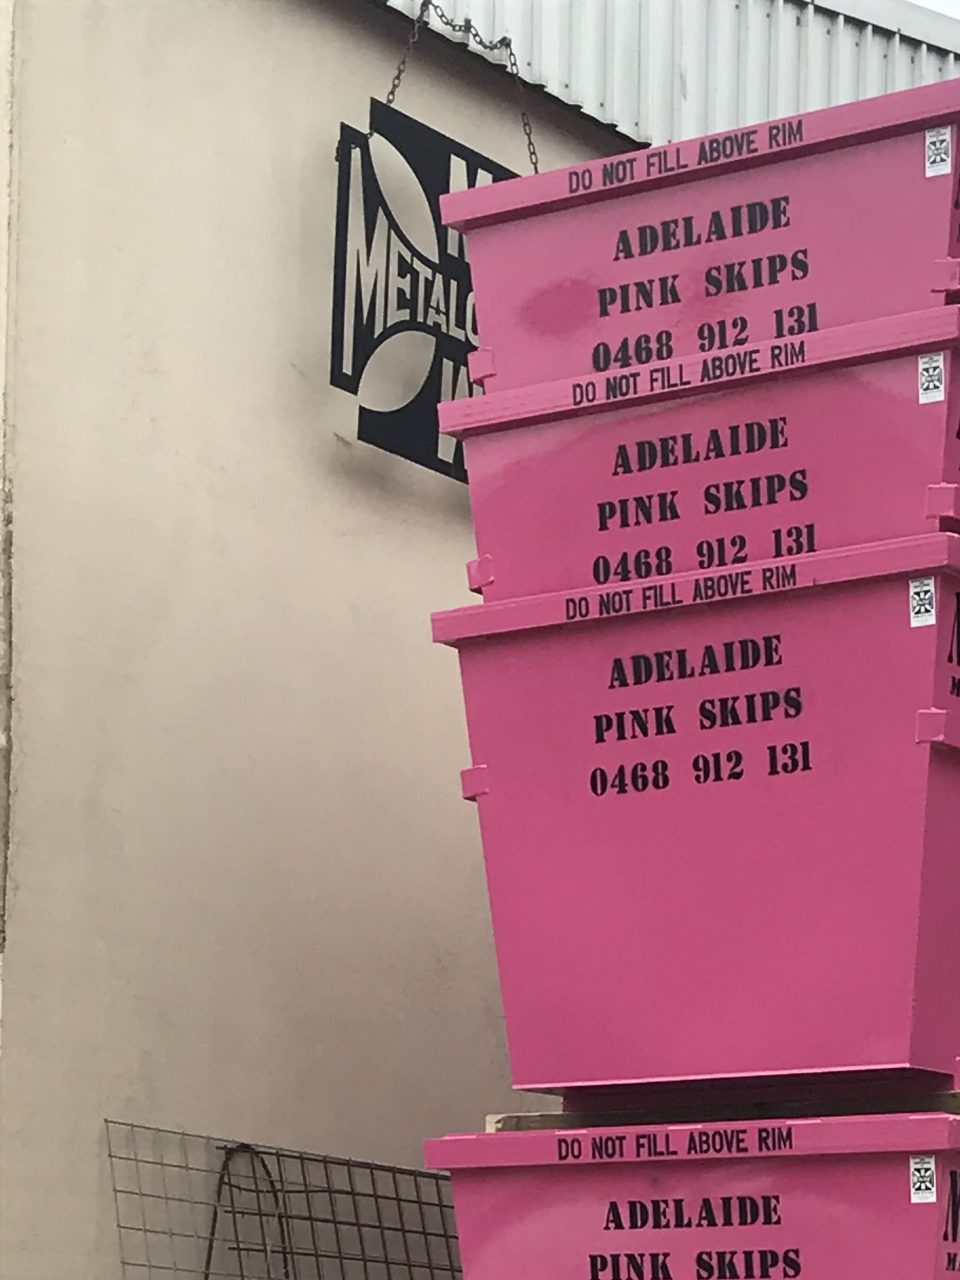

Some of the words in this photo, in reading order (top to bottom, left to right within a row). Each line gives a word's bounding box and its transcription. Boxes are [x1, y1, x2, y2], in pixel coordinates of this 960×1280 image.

[569, 169, 592, 193] DO
[602, 158, 636, 186] NOT
[647, 148, 688, 177] FILL
[698, 133, 757, 166] ABOVE
[769, 120, 803, 149] RIM
[613, 196, 790, 261] ADELAIDE
[598, 275, 681, 317] PINK
[705, 249, 808, 297] SKIPS
[592, 329, 674, 373] 0468
[698, 317, 748, 352] 912
[774, 303, 819, 338] 131
[573, 381, 596, 406] DO
[606, 372, 640, 400] NOT
[650, 364, 691, 392] FILL
[701, 350, 760, 382] ABOVE
[771, 341, 806, 365] RIM
[612, 417, 788, 476] ADELAIDE
[598, 491, 680, 531] PINK
[704, 469, 808, 514] SKIPS
[593, 546, 672, 584] 0468
[697, 535, 747, 569] 912
[773, 524, 817, 558] 131
[566, 597, 589, 620] DO
[599, 590, 632, 616] NOT
[642, 583, 683, 609] FILL
[693, 571, 752, 602] ABOVE
[762, 564, 796, 590] RIM
[609, 635, 782, 689] ADELAIDE
[594, 706, 676, 743] PINK
[699, 687, 802, 730] SKIPS
[590, 760, 669, 796] 0468
[692, 751, 743, 784] 912
[767, 741, 811, 775] 131
[558, 1138, 581, 1161] DO
[592, 1136, 626, 1159] NOT
[636, 1134, 678, 1157] FILL
[688, 1129, 748, 1154] ABOVE
[758, 1127, 792, 1151] RIM
[604, 1195, 781, 1230] ADELAIDE
[696, 1249, 801, 1280] SKIPS
